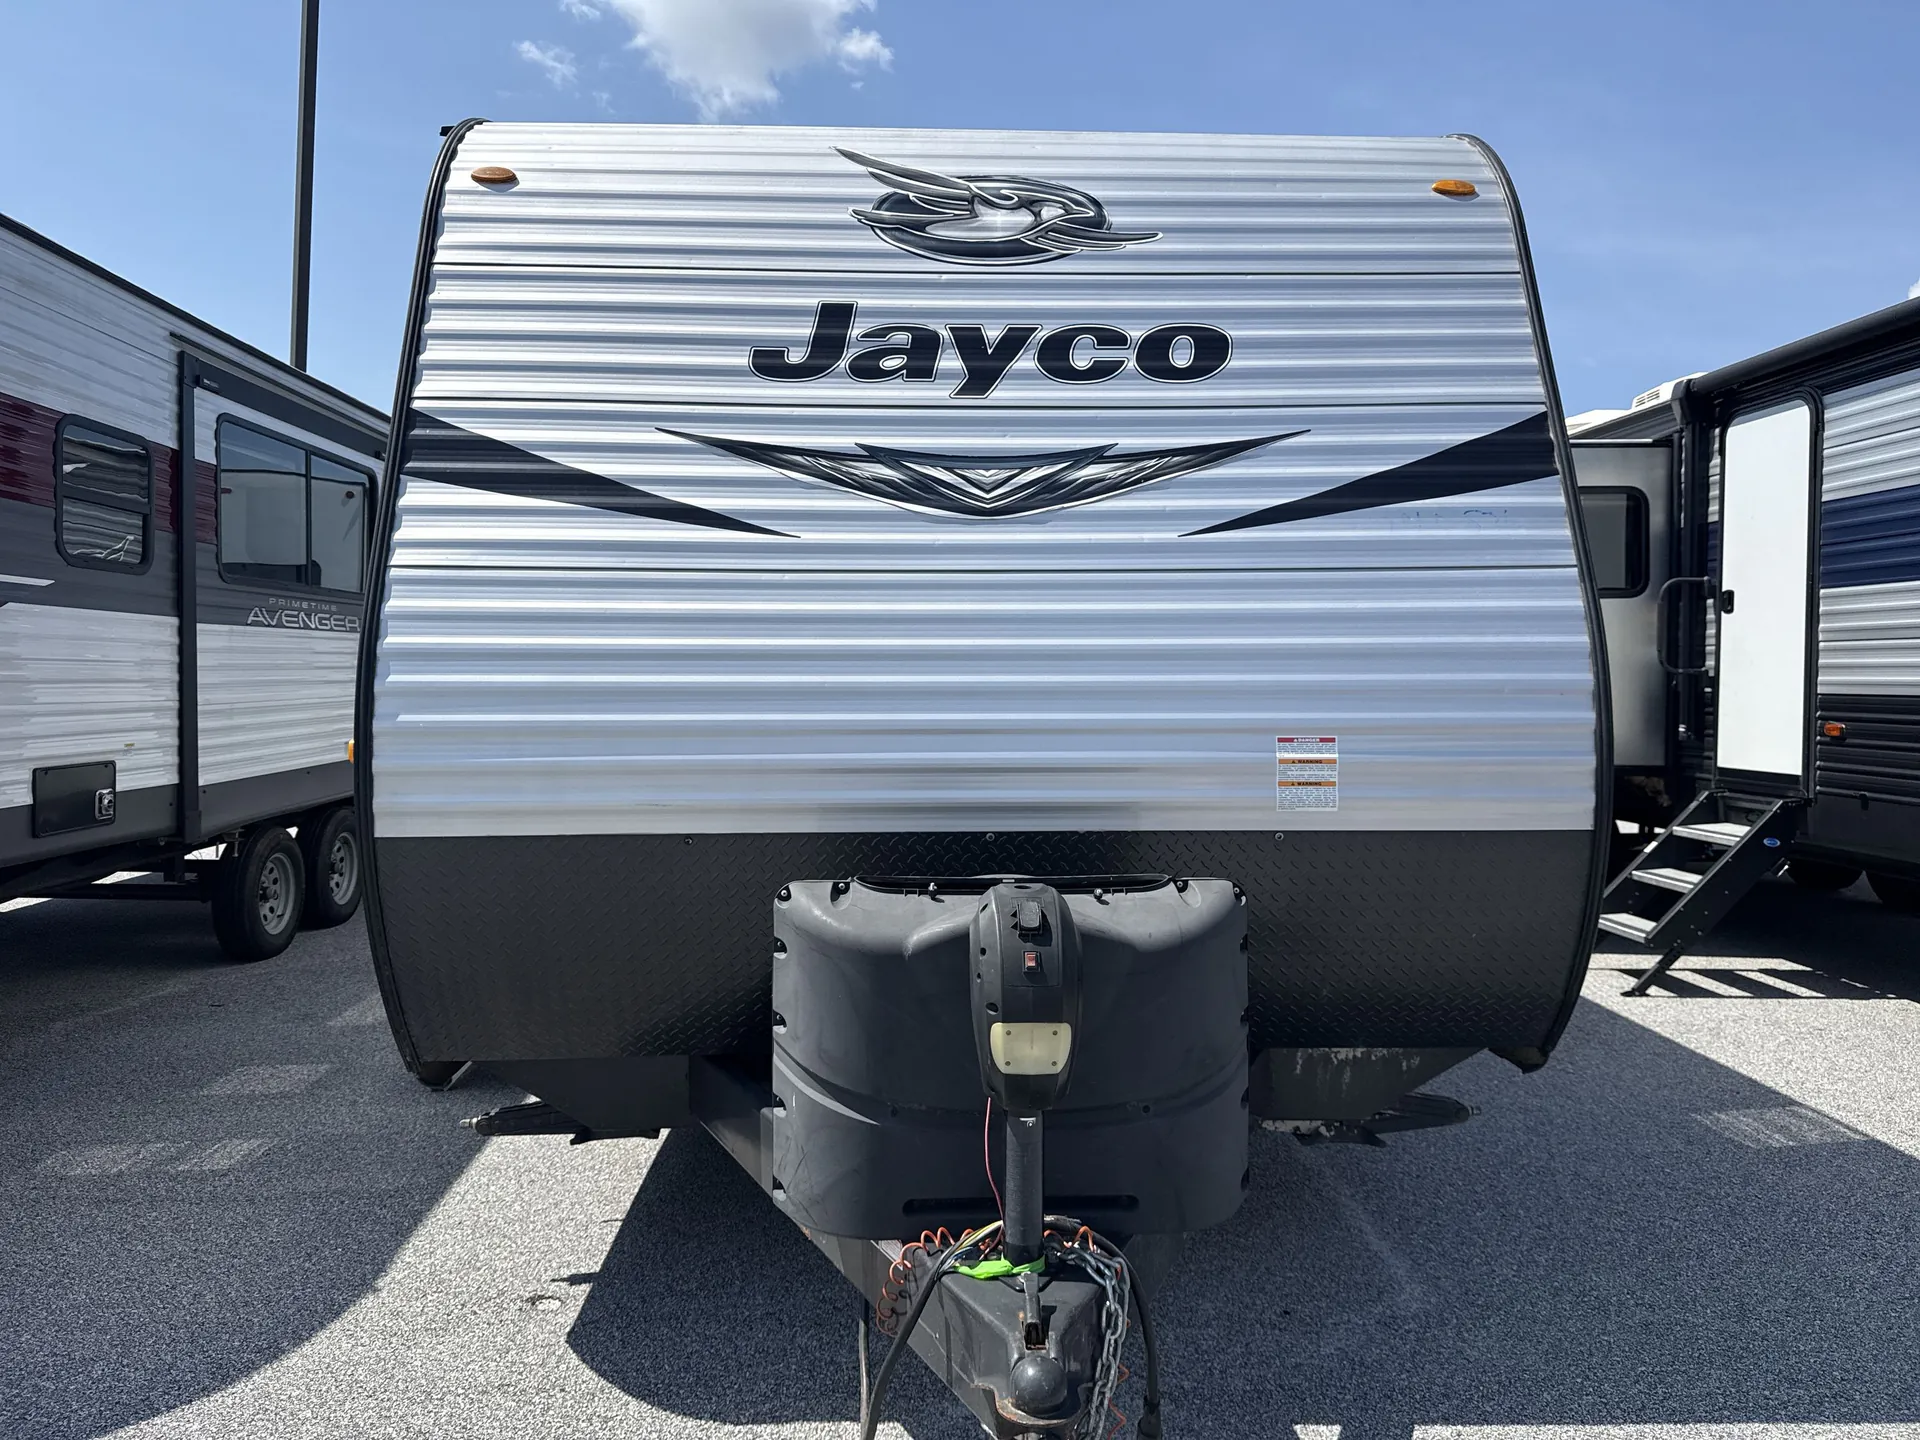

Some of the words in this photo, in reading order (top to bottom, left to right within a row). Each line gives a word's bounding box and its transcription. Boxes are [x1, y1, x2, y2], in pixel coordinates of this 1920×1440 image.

[748, 300, 1233, 398] Jayco
[268, 597, 337, 611] PRIMETIME
[246, 606, 361, 632] AVENGER
